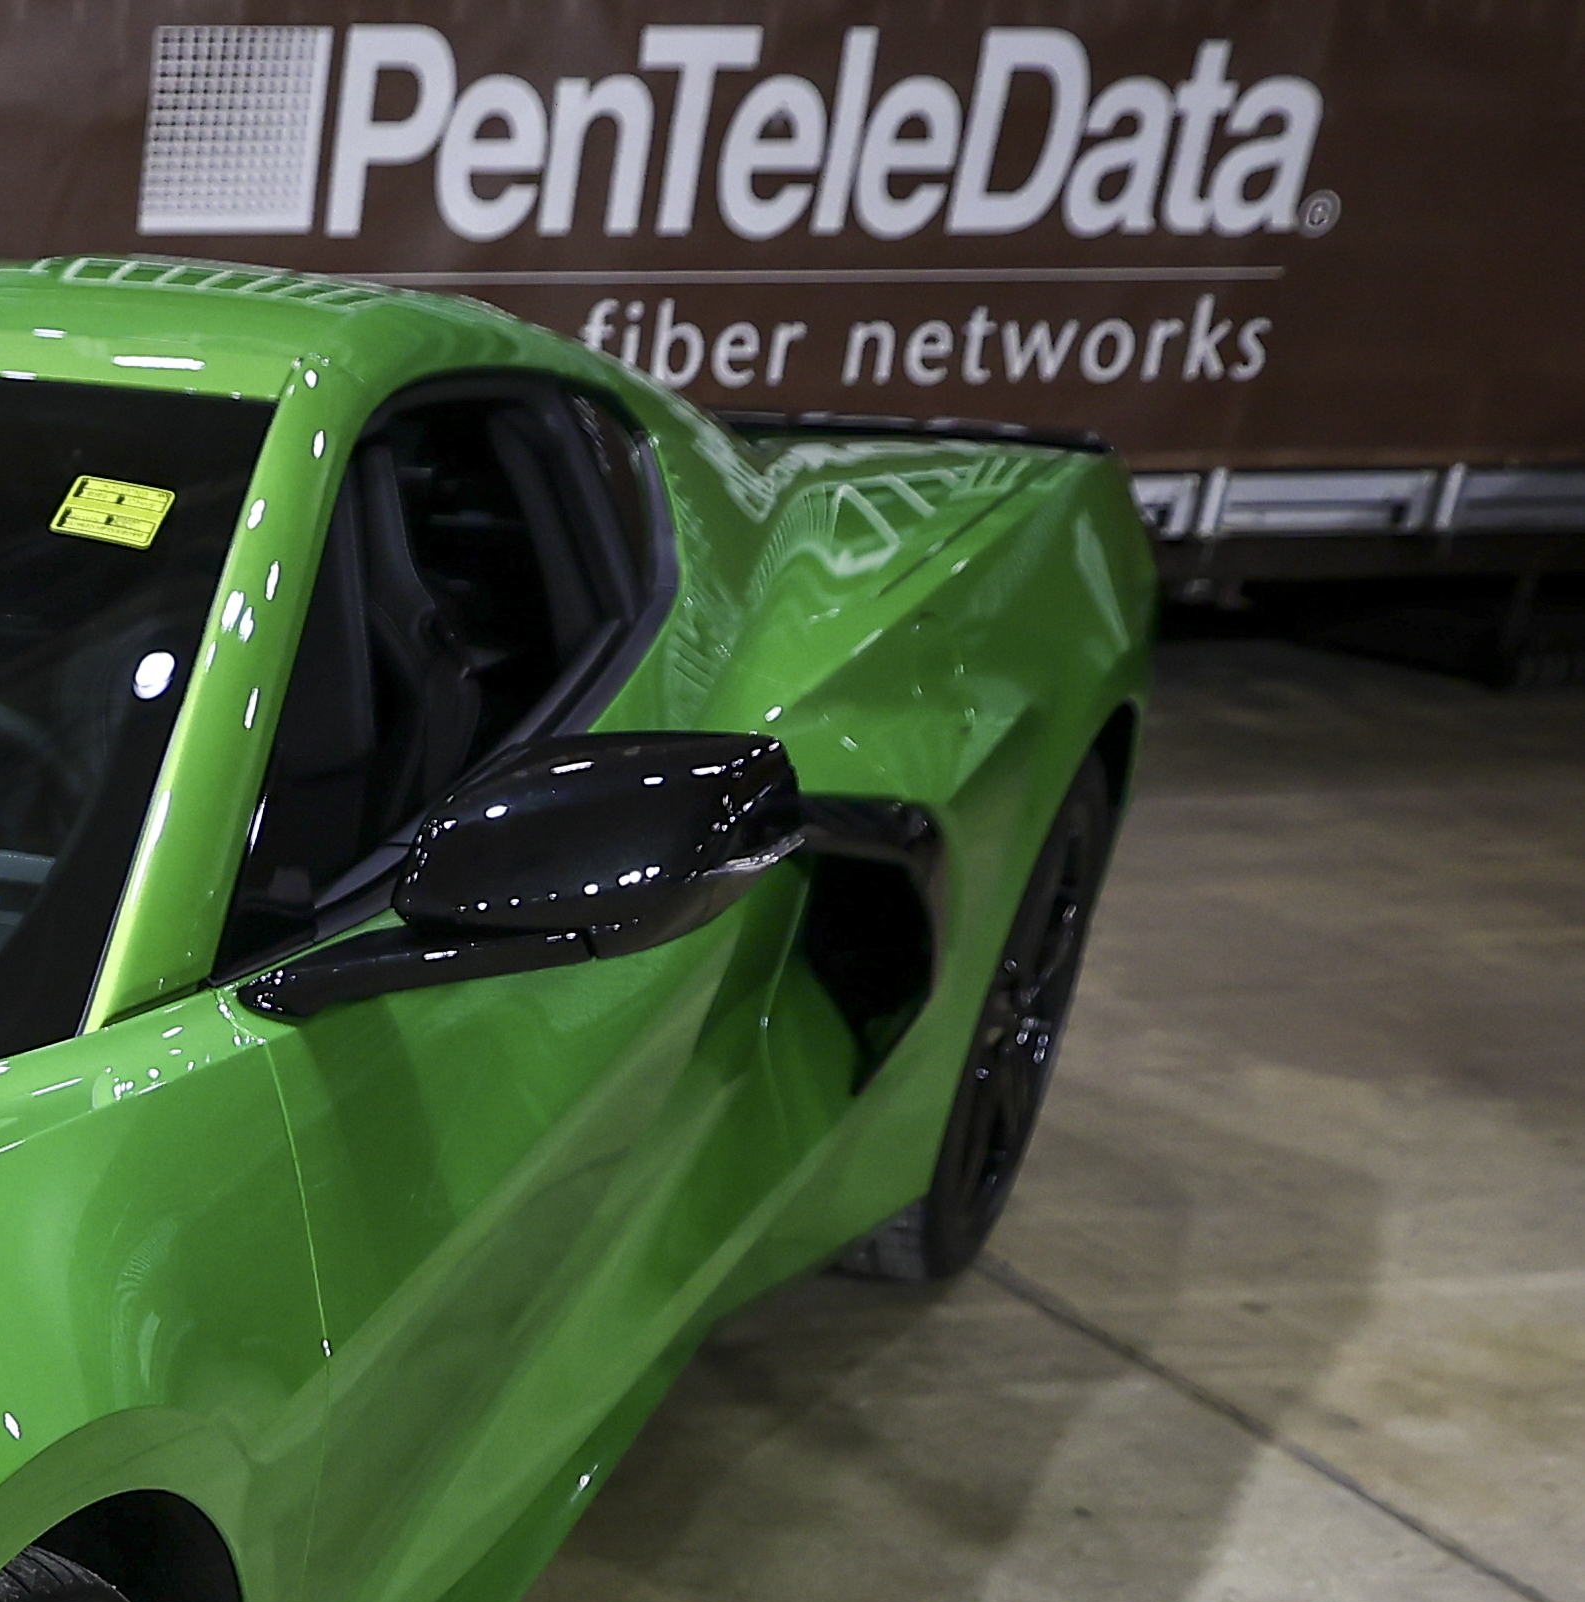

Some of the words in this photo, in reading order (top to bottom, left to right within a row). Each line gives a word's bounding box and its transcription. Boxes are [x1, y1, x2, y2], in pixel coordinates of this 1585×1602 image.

[326, 26, 1322, 240] PenTeleData
[579, 297, 808, 390] fiber
[842, 294, 1271, 386] networks
